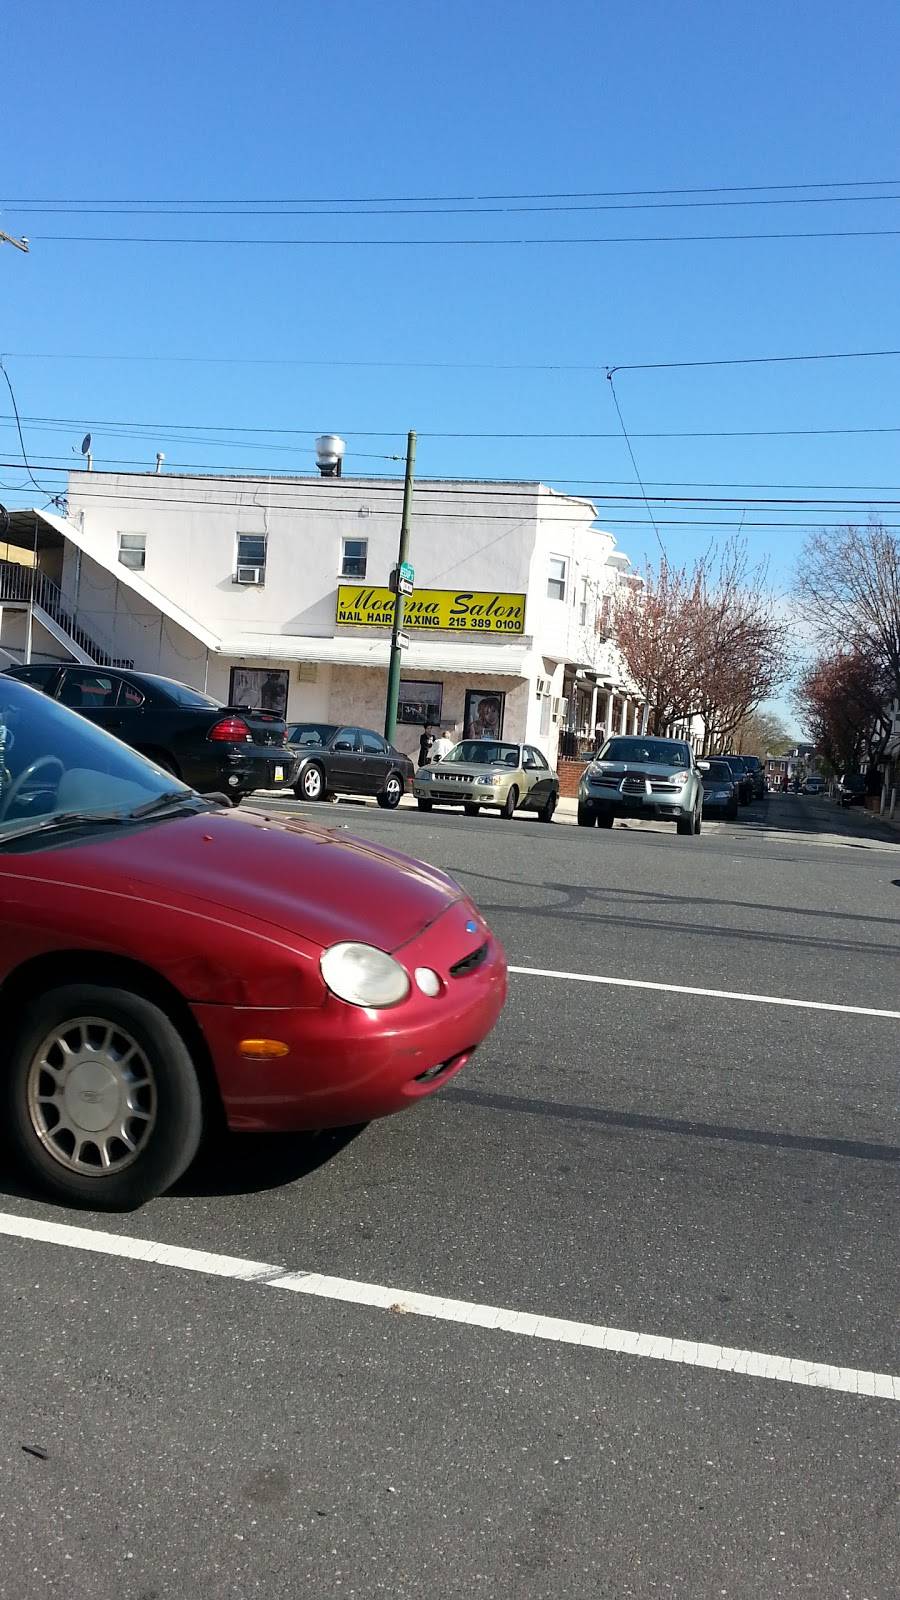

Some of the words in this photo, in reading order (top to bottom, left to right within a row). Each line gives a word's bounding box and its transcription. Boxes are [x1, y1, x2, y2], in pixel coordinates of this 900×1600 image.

[340, 590, 441, 613] Modna
[449, 594, 522, 618] Salon
[339, 611, 362, 621] NAIL
[367, 612, 392, 622] HAIR
[402, 615, 440, 626] AXING
[448, 617, 467, 627] 215
[471, 618, 491, 628] 389
[496, 619, 521, 630] 0100
